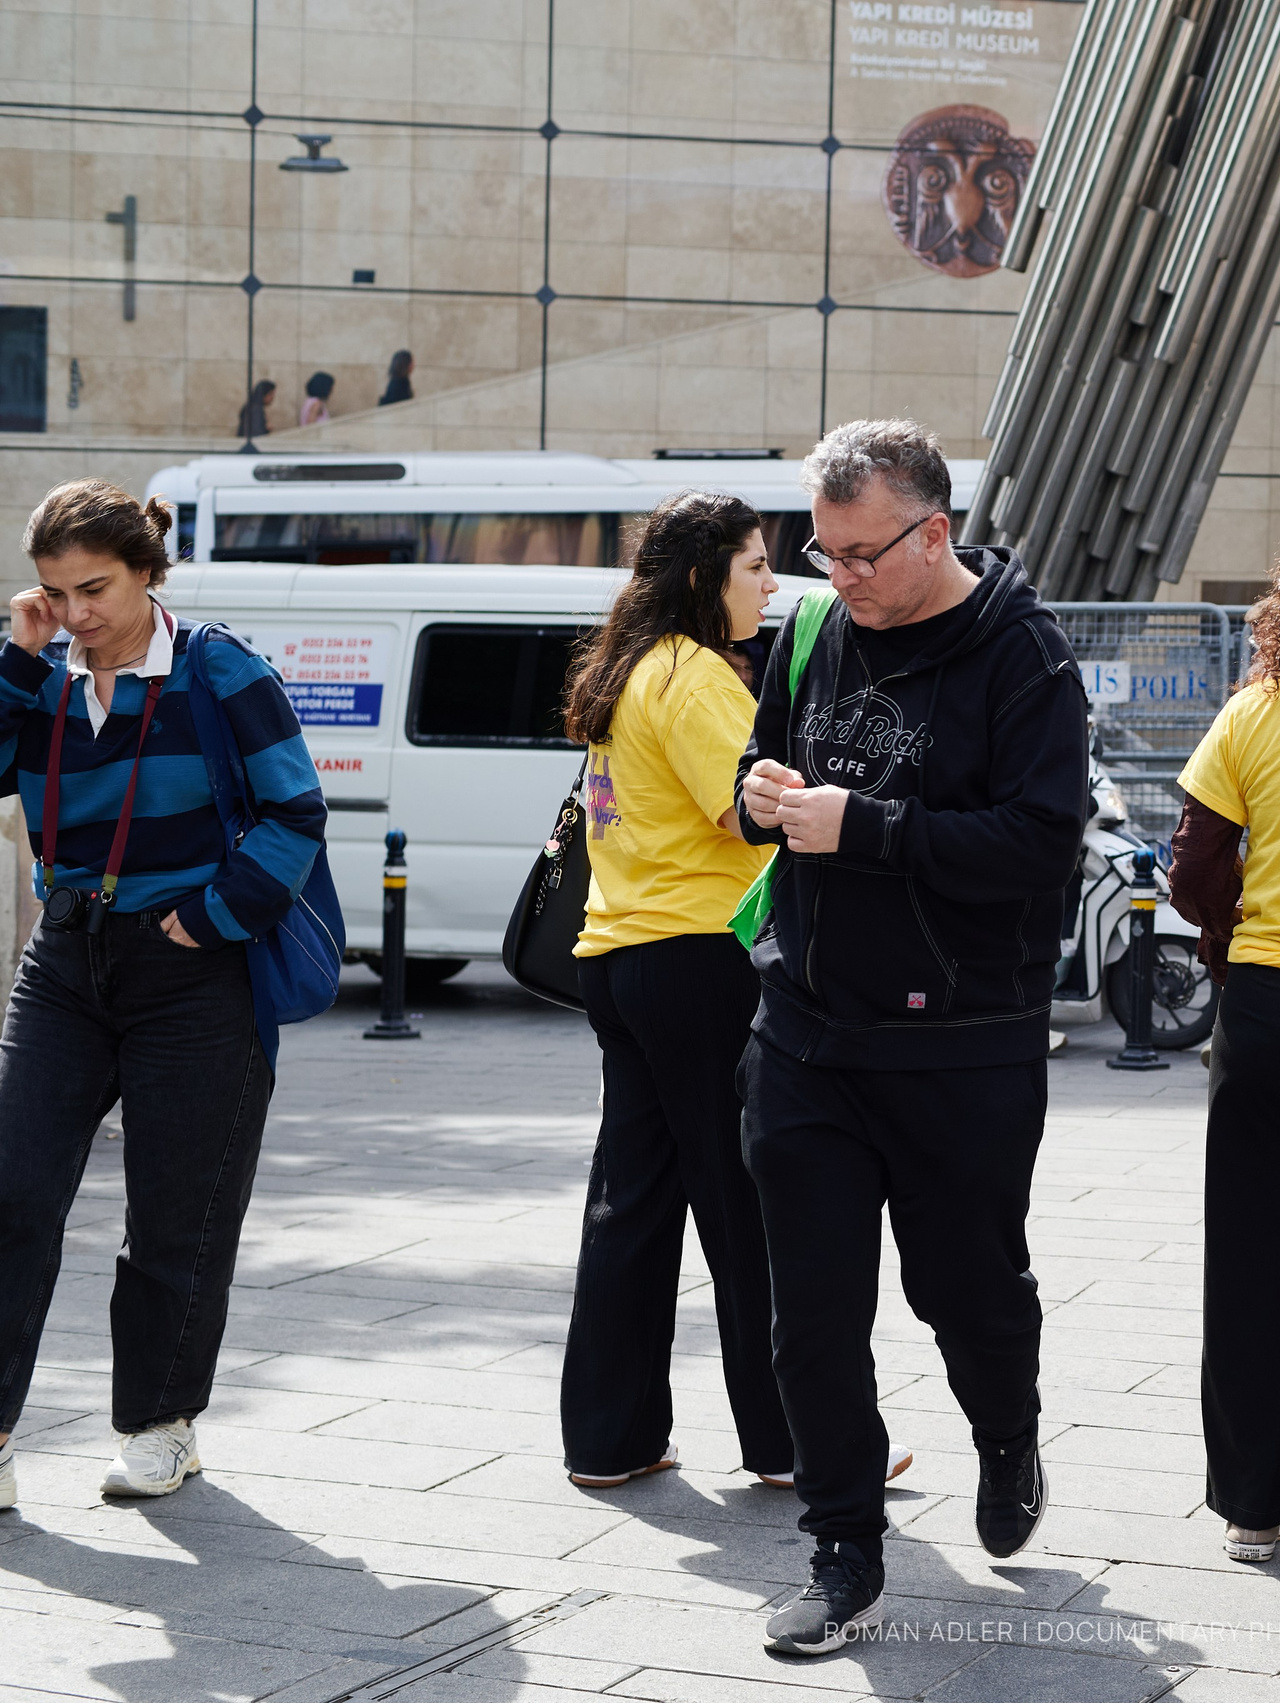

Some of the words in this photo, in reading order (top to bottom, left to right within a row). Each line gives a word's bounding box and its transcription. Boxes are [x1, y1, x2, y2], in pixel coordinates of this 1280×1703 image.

[851, 1, 892, 21] YAPI
[898, 3, 955, 24] KREDİ
[961, 6, 1033, 30] MÜZESİ
[850, 26, 888, 45] YAPI
[895, 28, 949, 49] KREDİ
[955, 33, 1039, 54] MUSEUM
[793, 703, 863, 744] Hard
[856, 715, 934, 766] Rock
[827, 757, 866, 777] CAFE
